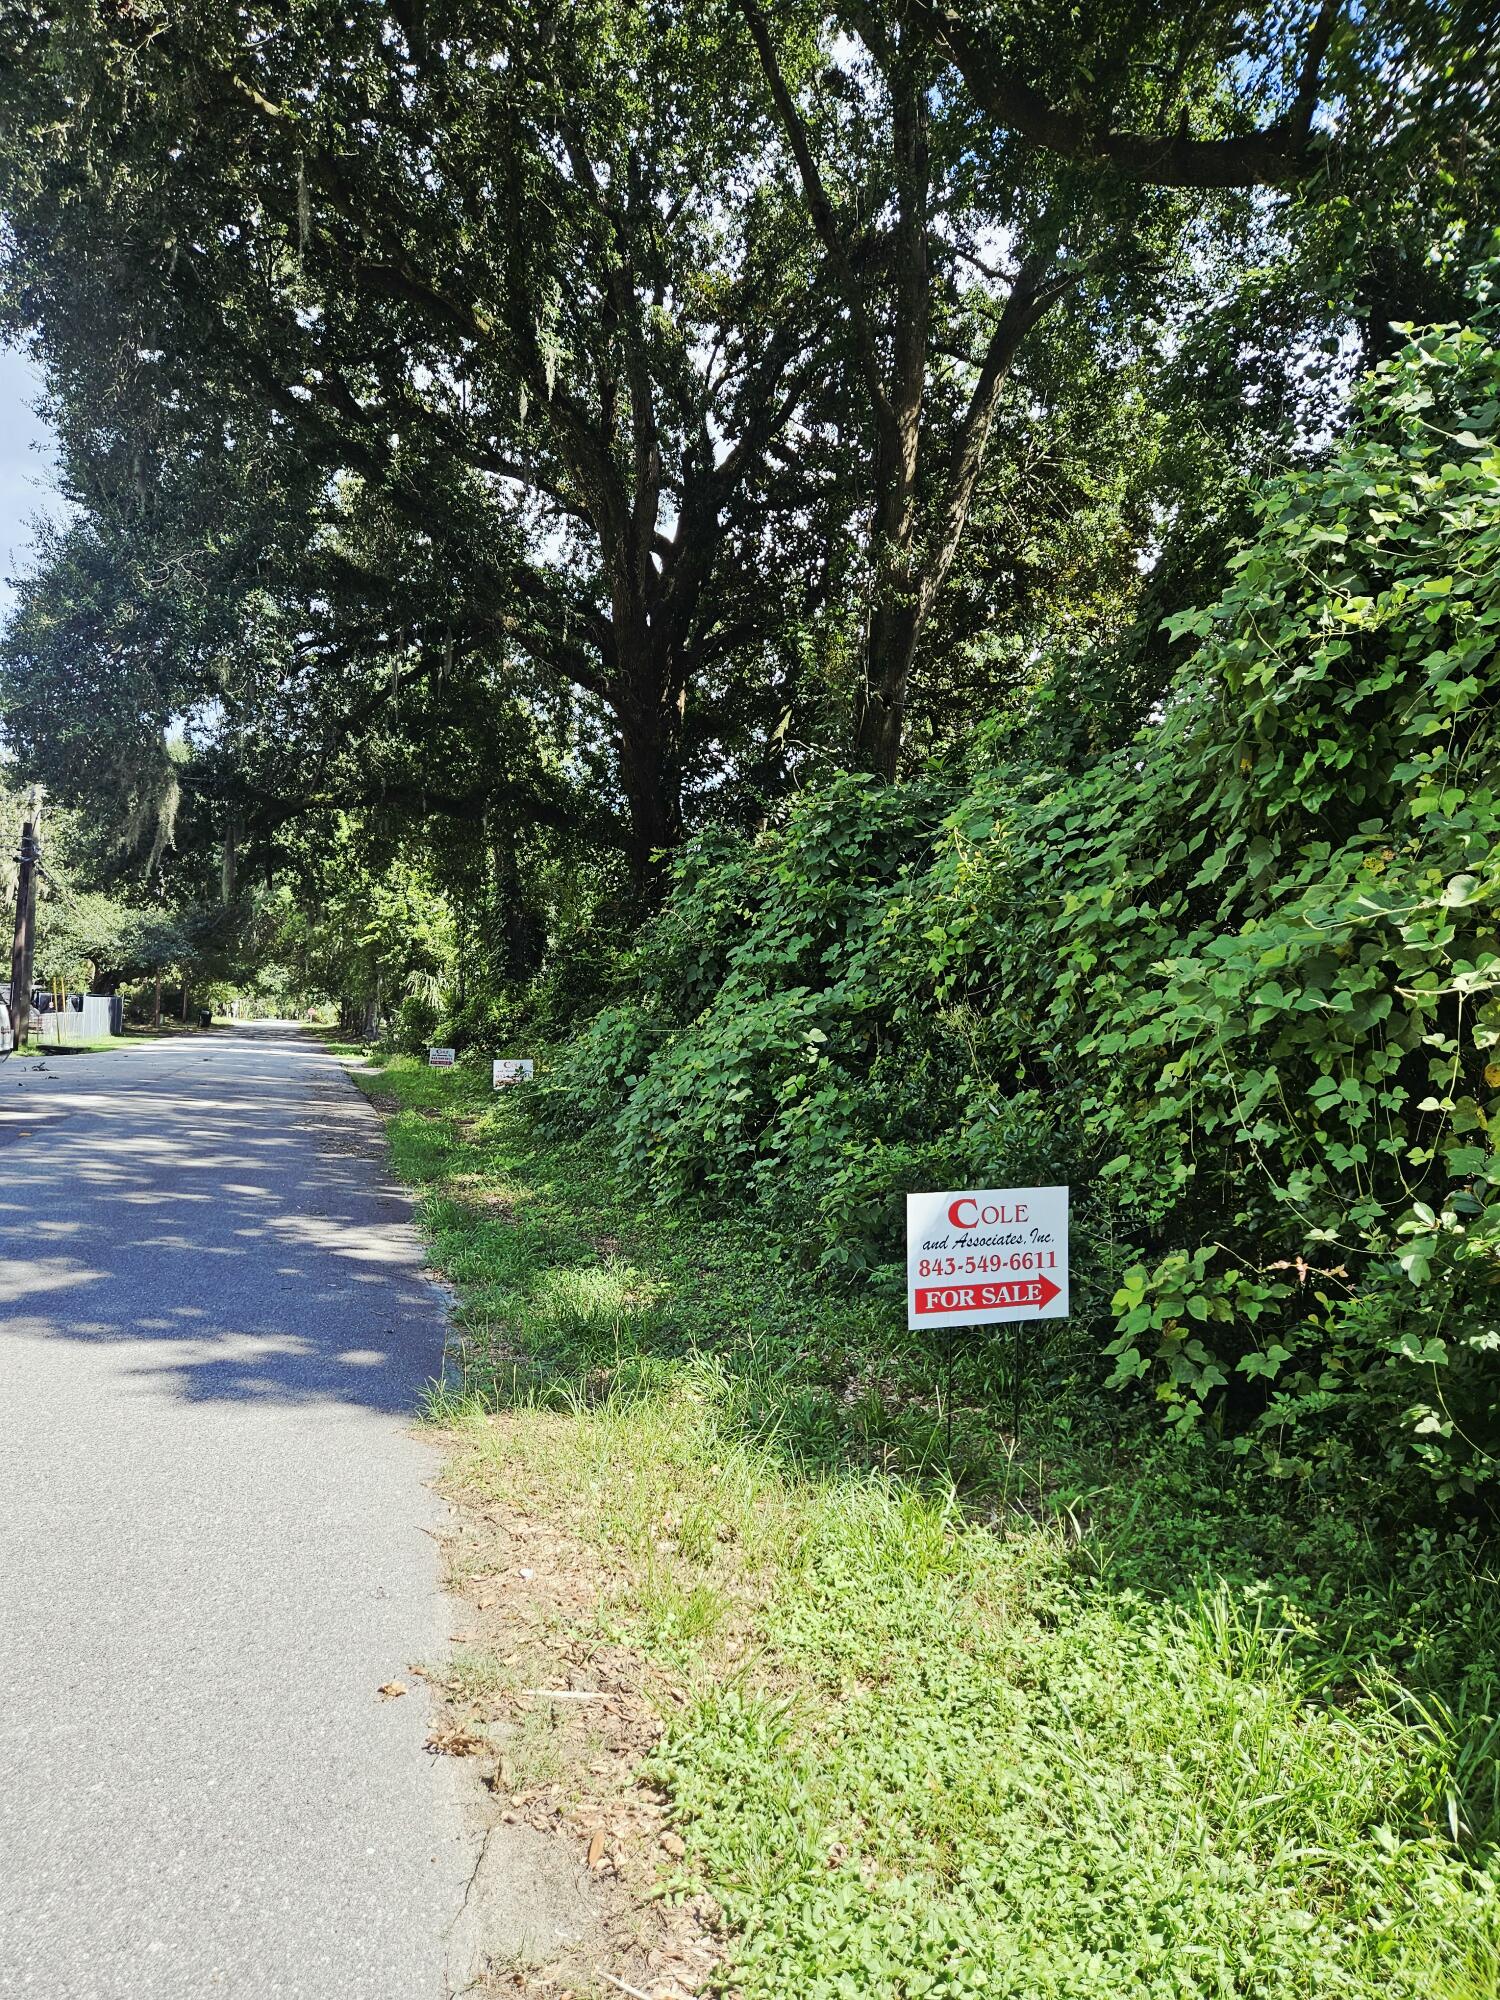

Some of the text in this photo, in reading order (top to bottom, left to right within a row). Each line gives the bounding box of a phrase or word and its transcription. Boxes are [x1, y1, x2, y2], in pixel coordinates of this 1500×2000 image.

[947, 1198, 1029, 1229] COLE
[922, 1227, 1054, 1251] and Associates, Inc.
[918, 1250, 1059, 1278] 843-549-6611
[925, 1283, 1043, 1309] FOR SALE
